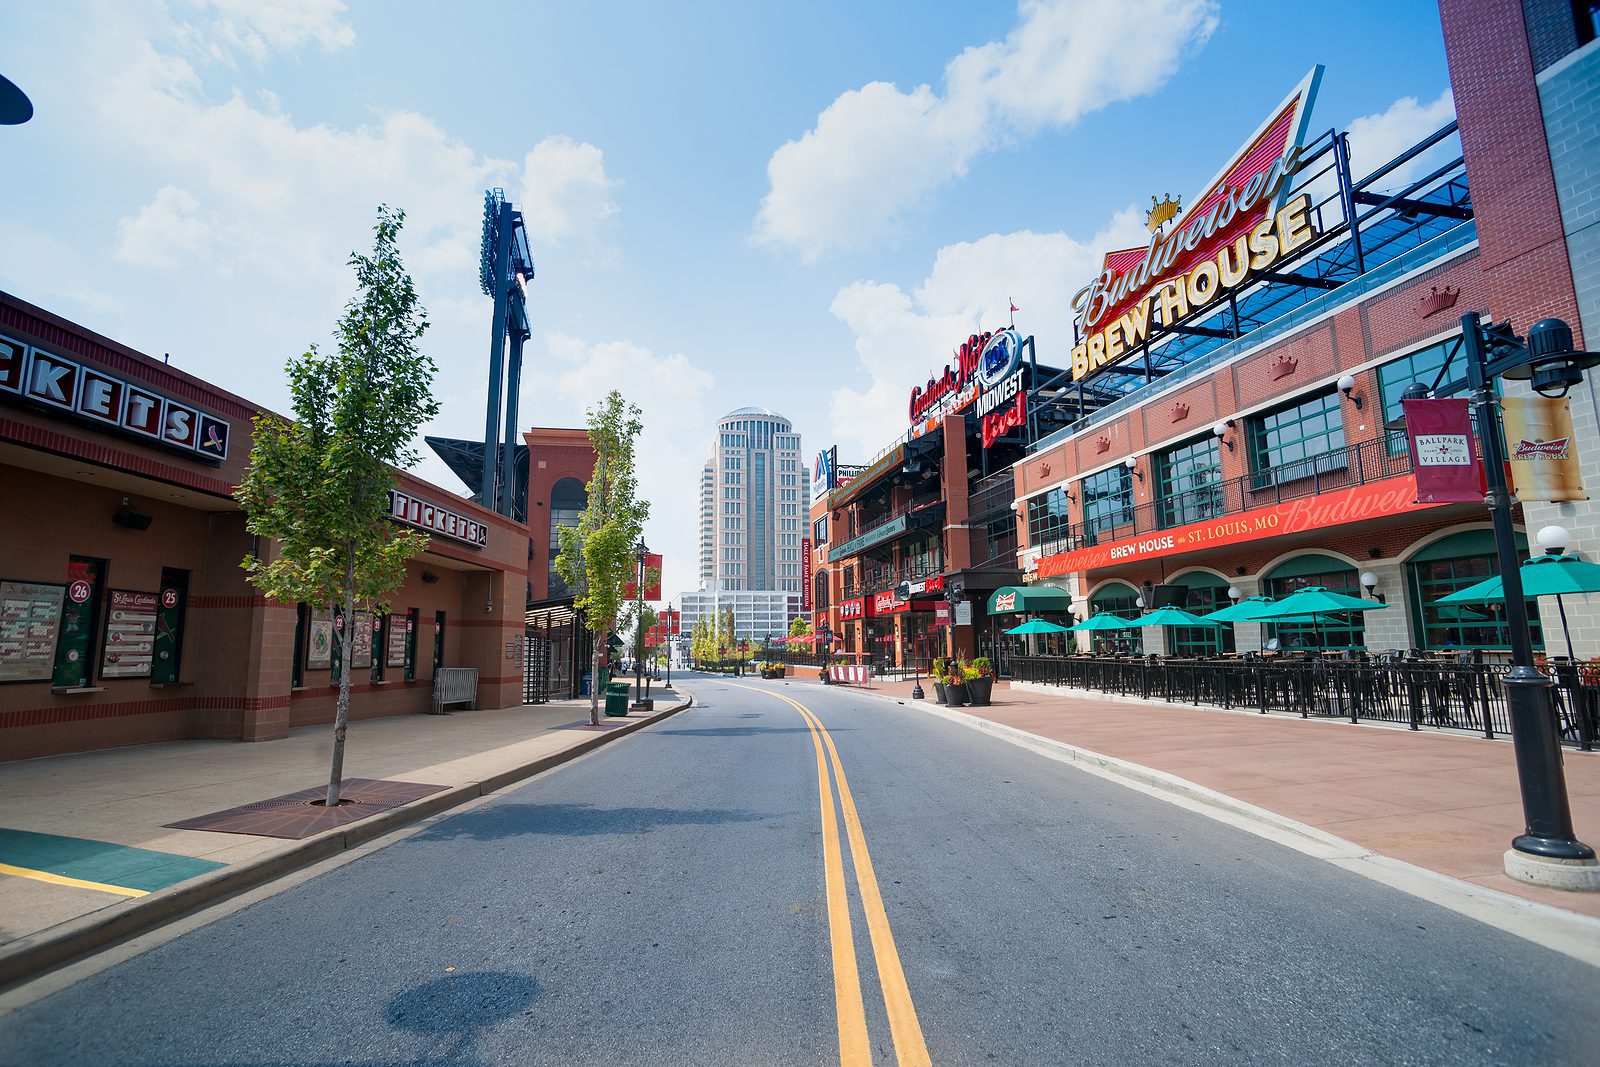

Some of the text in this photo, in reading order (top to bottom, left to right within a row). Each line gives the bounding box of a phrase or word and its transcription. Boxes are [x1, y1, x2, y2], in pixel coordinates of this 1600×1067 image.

[1070, 144, 1303, 335] Budweiser
[1071, 193, 1318, 382] BREW HOUSE
[984, 336, 1010, 371] FOX
[908, 364, 957, 426] Cardinals
[976, 366, 1024, 420] MIDWEST
[1418, 436, 1465, 446] BALLPARK
[1512, 442, 1569, 457] Budweiser
[1538, 452, 1569, 461] HOUSE
[837, 469, 864, 477] PHILLIP
[396, 496, 477, 541] TICKETS
[1037, 548, 1109, 578] Budweiser
[1110, 543, 1137, 559] BREW
[1138, 535, 1175, 554] HOUSE
[1188, 531, 1207, 544] ST.
[1208, 519, 1253, 539] LOUIS,
[1254, 514, 1279, 531] MO
[74, 585, 87, 598] 26
[165, 592, 176, 604] 25
[336, 618, 343, 627] 22
